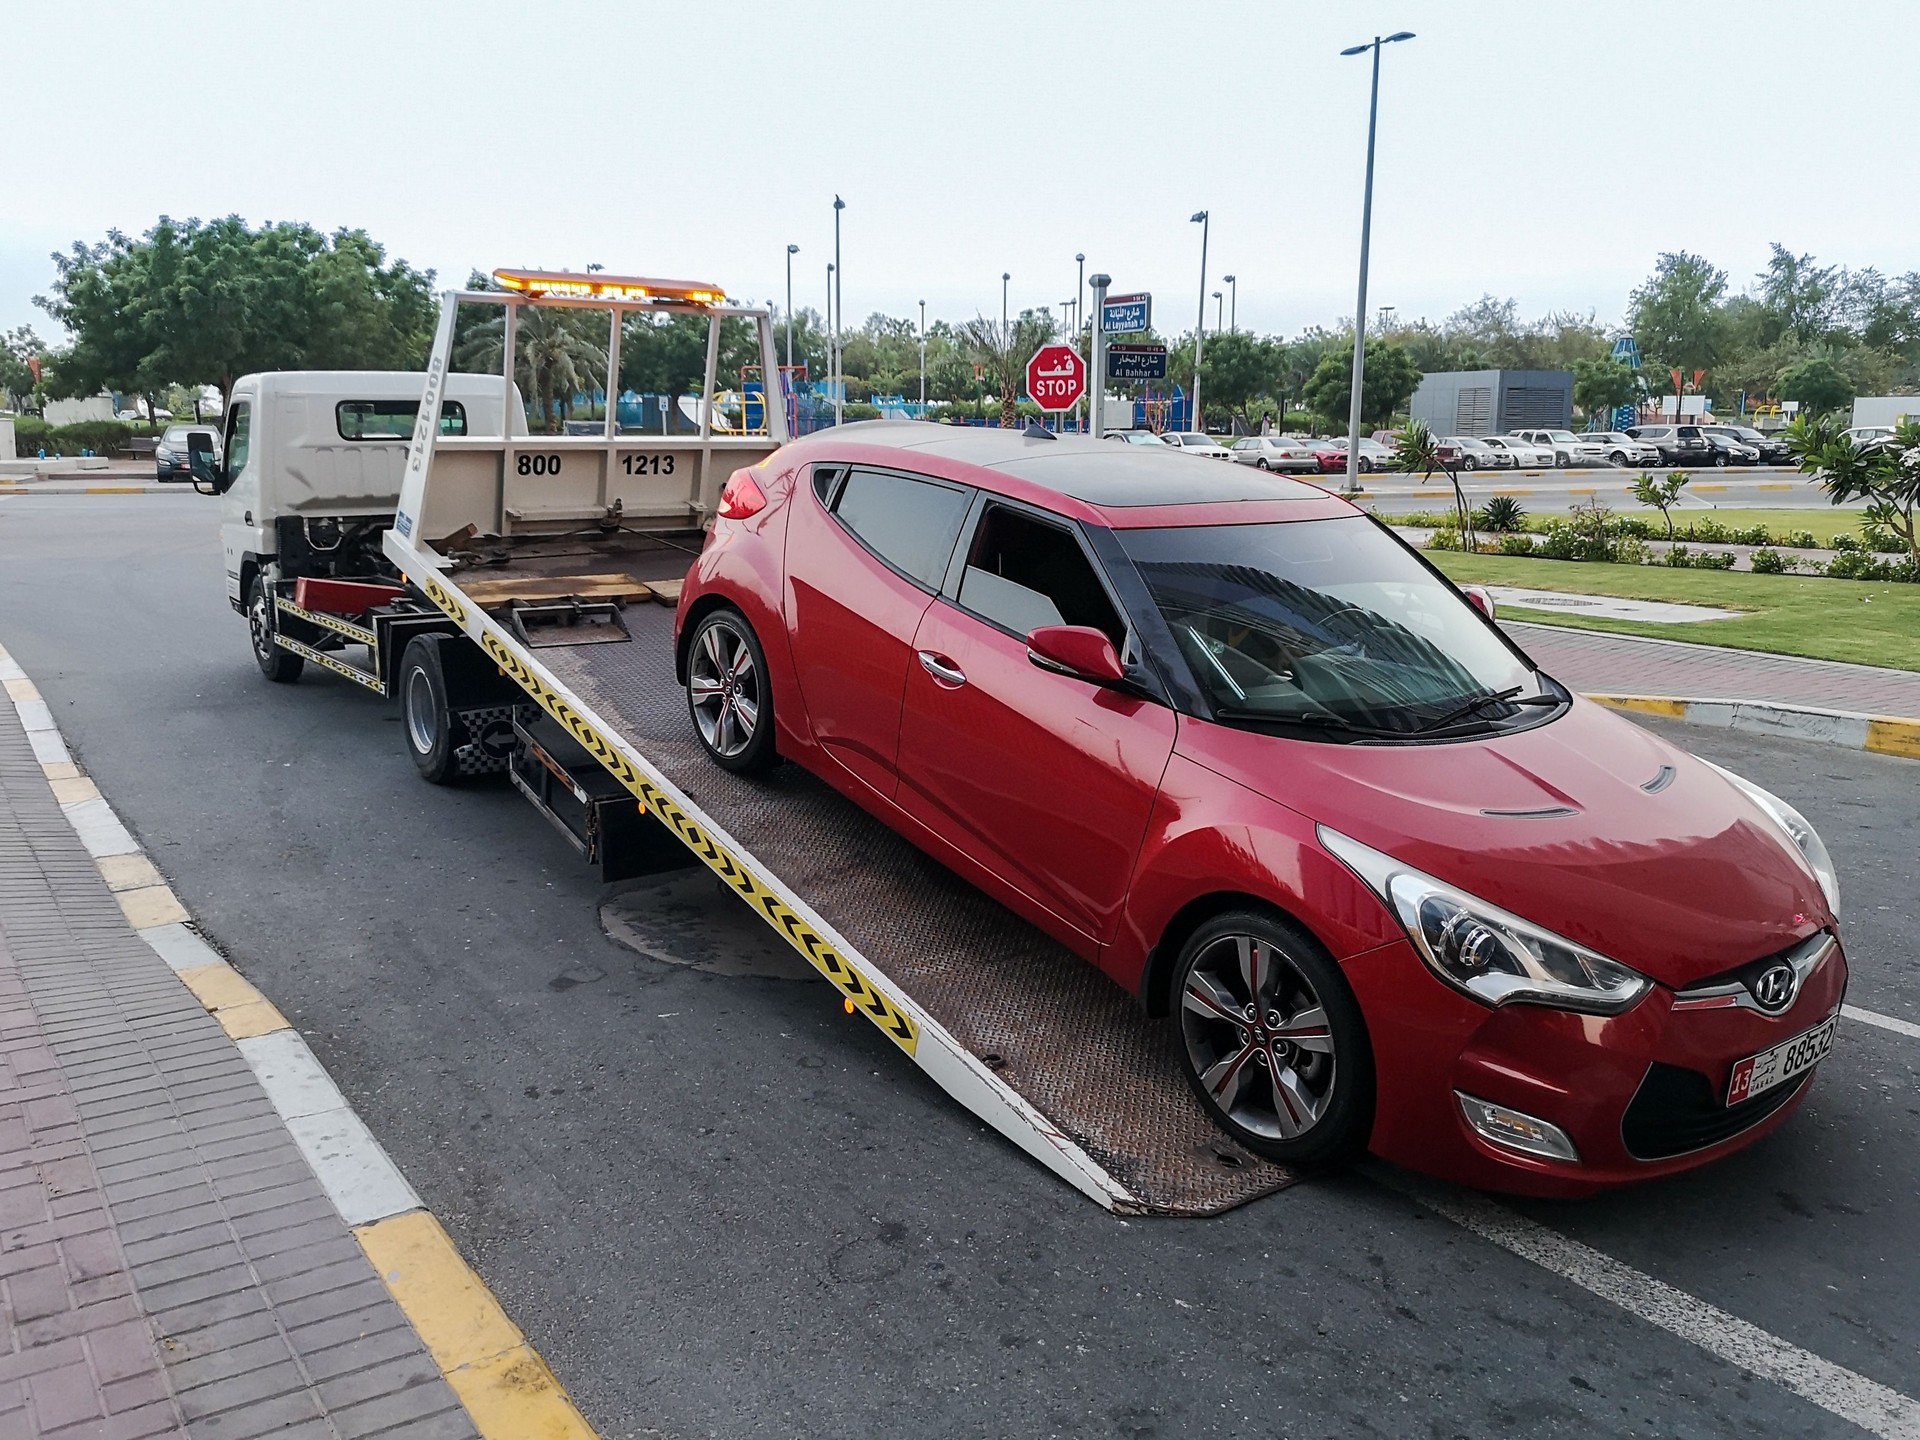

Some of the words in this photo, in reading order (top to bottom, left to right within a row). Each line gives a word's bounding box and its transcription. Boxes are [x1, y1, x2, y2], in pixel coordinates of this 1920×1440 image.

[1126, 306, 1140, 321] شارع
[1104, 321, 1111, 330] Al
[1036, 355, 1075, 377] قف
[1141, 355, 1158, 367] شارع
[1115, 368, 1122, 377] Al
[1125, 368, 1151, 377] Bahhar
[1036, 379, 1077, 397] STOP
[517, 454, 561, 476] 800
[622, 454, 675, 475] 1213
[1783, 1022, 1834, 1076] 88532
[1731, 1068, 1752, 1096] 13
